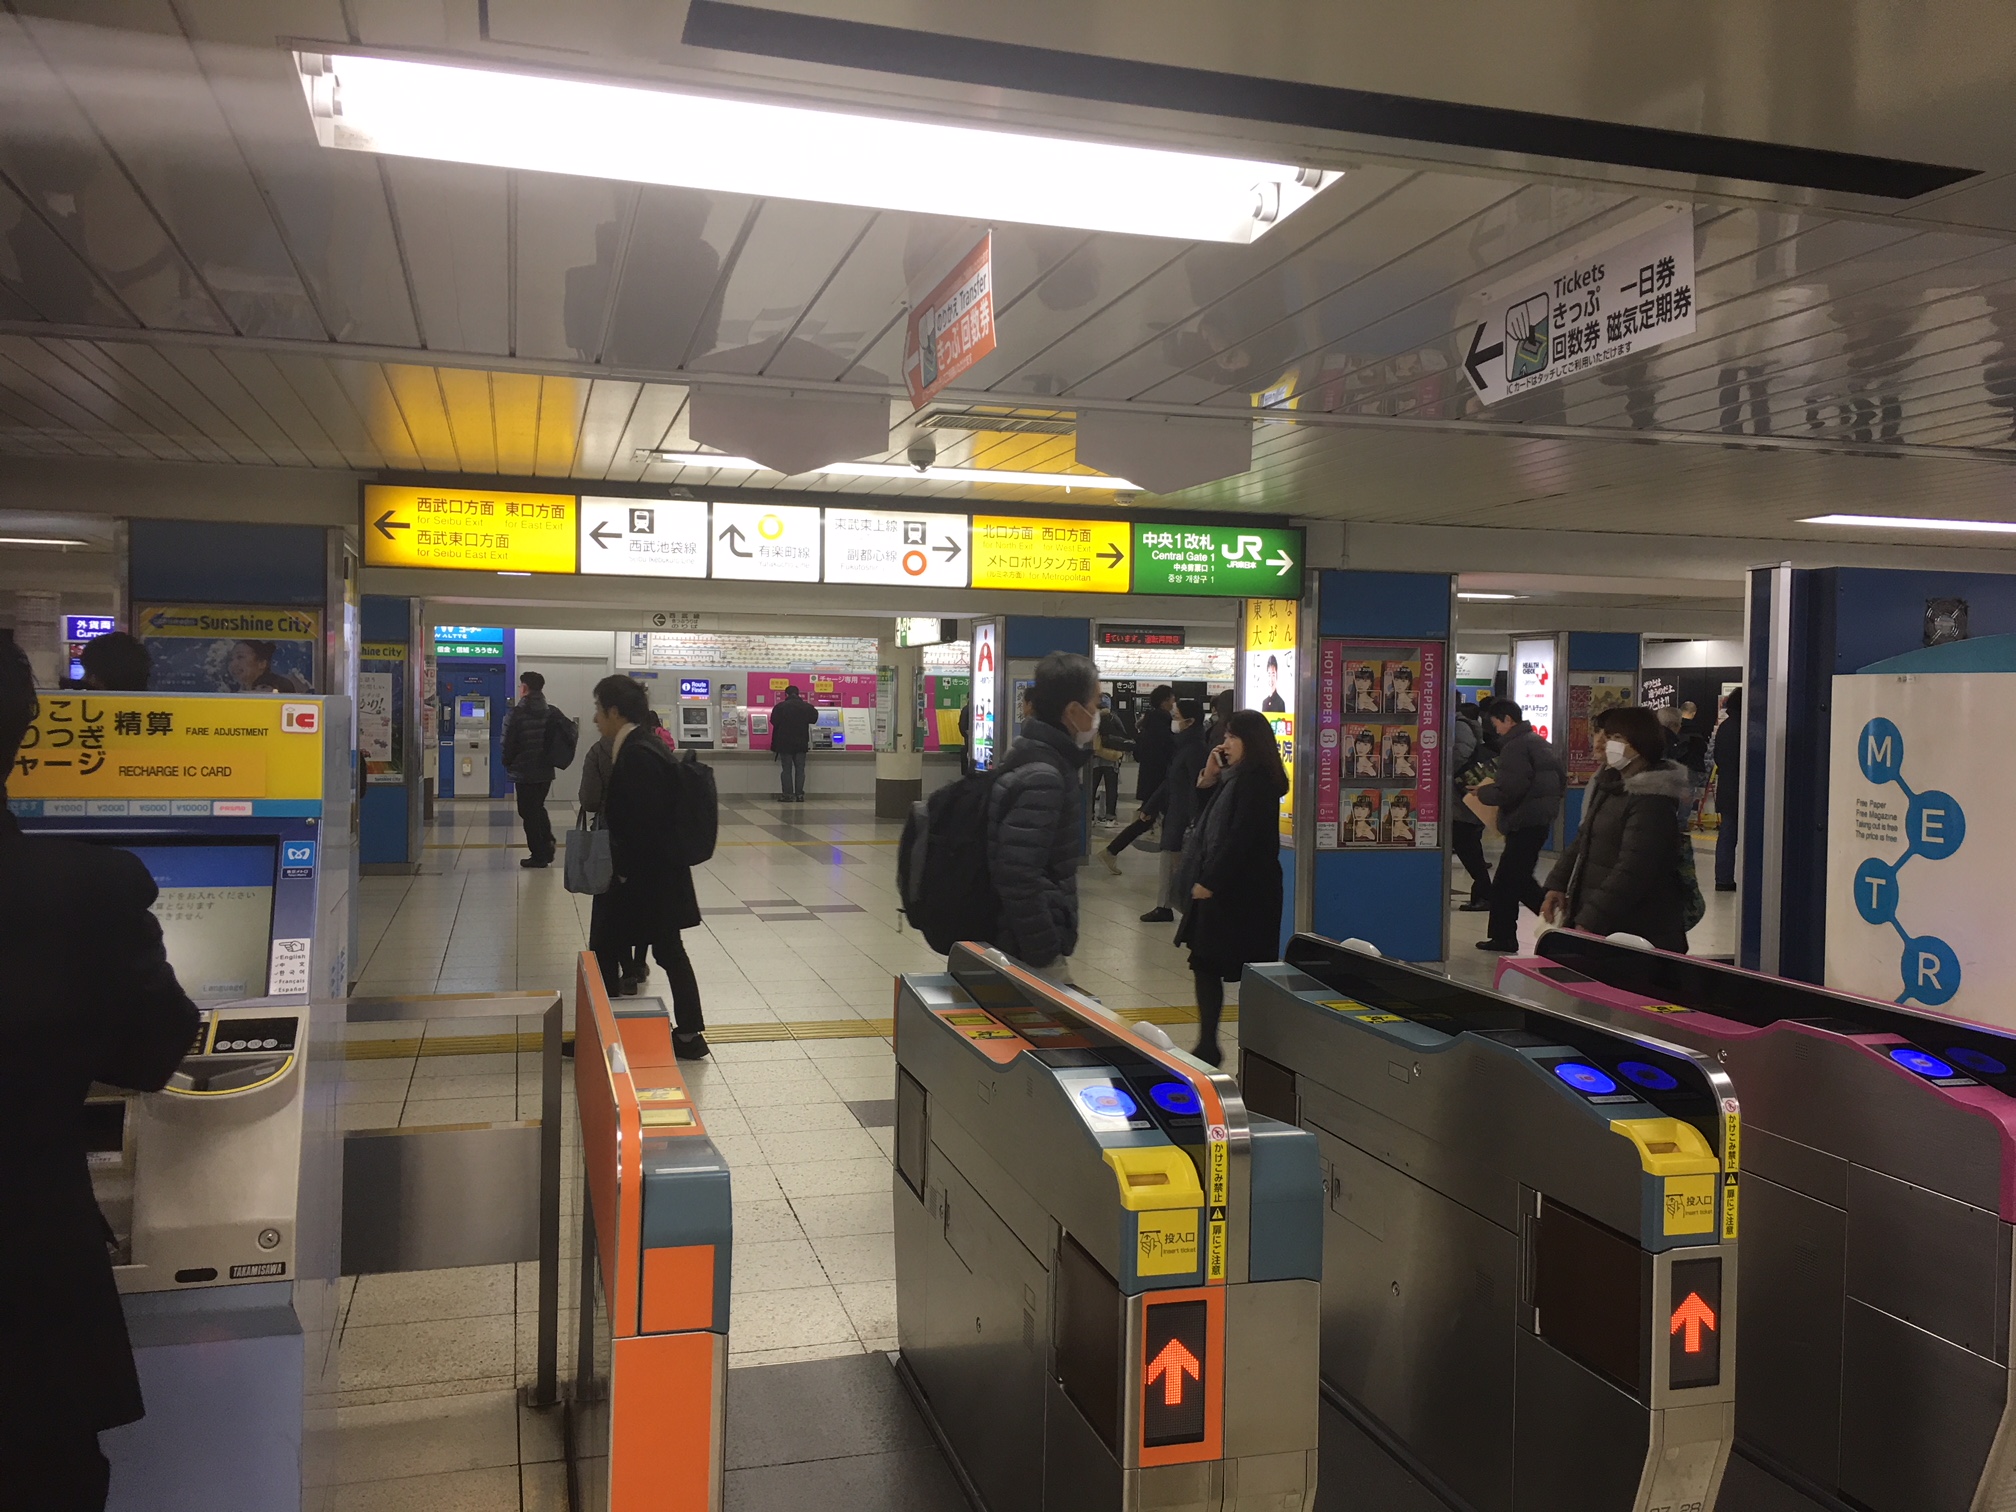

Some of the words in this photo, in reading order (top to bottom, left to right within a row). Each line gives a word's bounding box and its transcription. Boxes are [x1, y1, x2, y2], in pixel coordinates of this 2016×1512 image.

[1553, 263, 1605, 298] Tickets
[1620, 255, 1676, 298] 一日券
[959, 273, 987, 314] Transfer
[1553, 286, 1601, 330] きっぷ
[1606, 285, 1692, 344] 磁気定期券
[961, 298, 990, 354] 回数券
[1552, 320, 1601, 364] 回数券
[417, 497, 494, 516] 西武口方面
[505, 502, 565, 520] 東口方面
[417, 515, 430, 524] for
[433, 516, 462, 526] Seibu
[465, 517, 484, 527] Exit
[505, 519, 517, 528] for
[521, 520, 543, 530] East
[545, 521, 563, 531] Exit
[835, 518, 898, 532] 東武東上線
[417, 529, 509, 549] 西武東口方面
[983, 524, 1033, 540] 北口方面
[1042, 527, 1091, 543] 西口方面
[1143, 531, 1215, 550] 中央1改札
[417, 547, 430, 557] for
[433, 548, 462, 558] Seibu
[465, 549, 487, 559] East
[490, 550, 508, 560] Exit
[629, 539, 697, 555] 西武池袋線
[759, 545, 811, 559] 有楽町線
[1019, 543, 1033, 551] Exit
[1077, 545, 1091, 553] Exit
[1221, 535, 1263, 560] JR
[847, 549, 898, 562] 副都心線
[987, 555, 1091, 572] メトロポリタン方面
[1152, 550, 1184, 561] Central
[1186, 552, 1208, 562] Gate
[1210, 553, 1215, 562] 1
[1029, 572, 1039, 580] for
[1042, 573, 1091, 582] Metropolitan
[200, 614, 274, 632] Sunshine
[277, 616, 313, 634] City
[382, 647, 402, 657] City
[1324, 651, 1334, 676] HOT
[1424, 653, 1434, 679] HOT
[1323, 679, 1333, 724] PEPPER
[1423, 681, 1433, 725] PEPPER
[114, 711, 173, 737] 精算
[186, 727, 210, 736] FARE
[214, 727, 269, 737] ADJUSTMENT
[118, 766, 179, 777] RECHARGE
[183, 766, 197, 777] IC
[200, 766, 232, 777] CARD
[54, 804, 83, 813] ¥1000
[97, 804, 125, 813] ¥2000
[139, 804, 168, 813] ¥5000
[1856, 798, 1868, 807] Free
[1869, 799, 1887, 810] Paper
[1856, 809, 1868, 818] Free
[1869, 811, 1898, 821] Magazine
[1856, 819, 1872, 831] Taking
[1887, 823, 1898, 832] free
[1855, 830, 1865, 839] The
[1866, 832, 1879, 841] price
[1885, 834, 1898, 843] free
[1727, 1114, 1737, 1169] かけこみ禁止
[1213, 1143, 1224, 1203] かけこみ禁止
[1686, 1196, 1712, 1206] 投入口
[1725, 1189, 1736, 1235] 扉にご注意
[1164, 1232, 1195, 1244] 投入口
[1211, 1225, 1222, 1275] 扉にご注意
[233, 1263, 282, 1278] TAKAMISAWA
